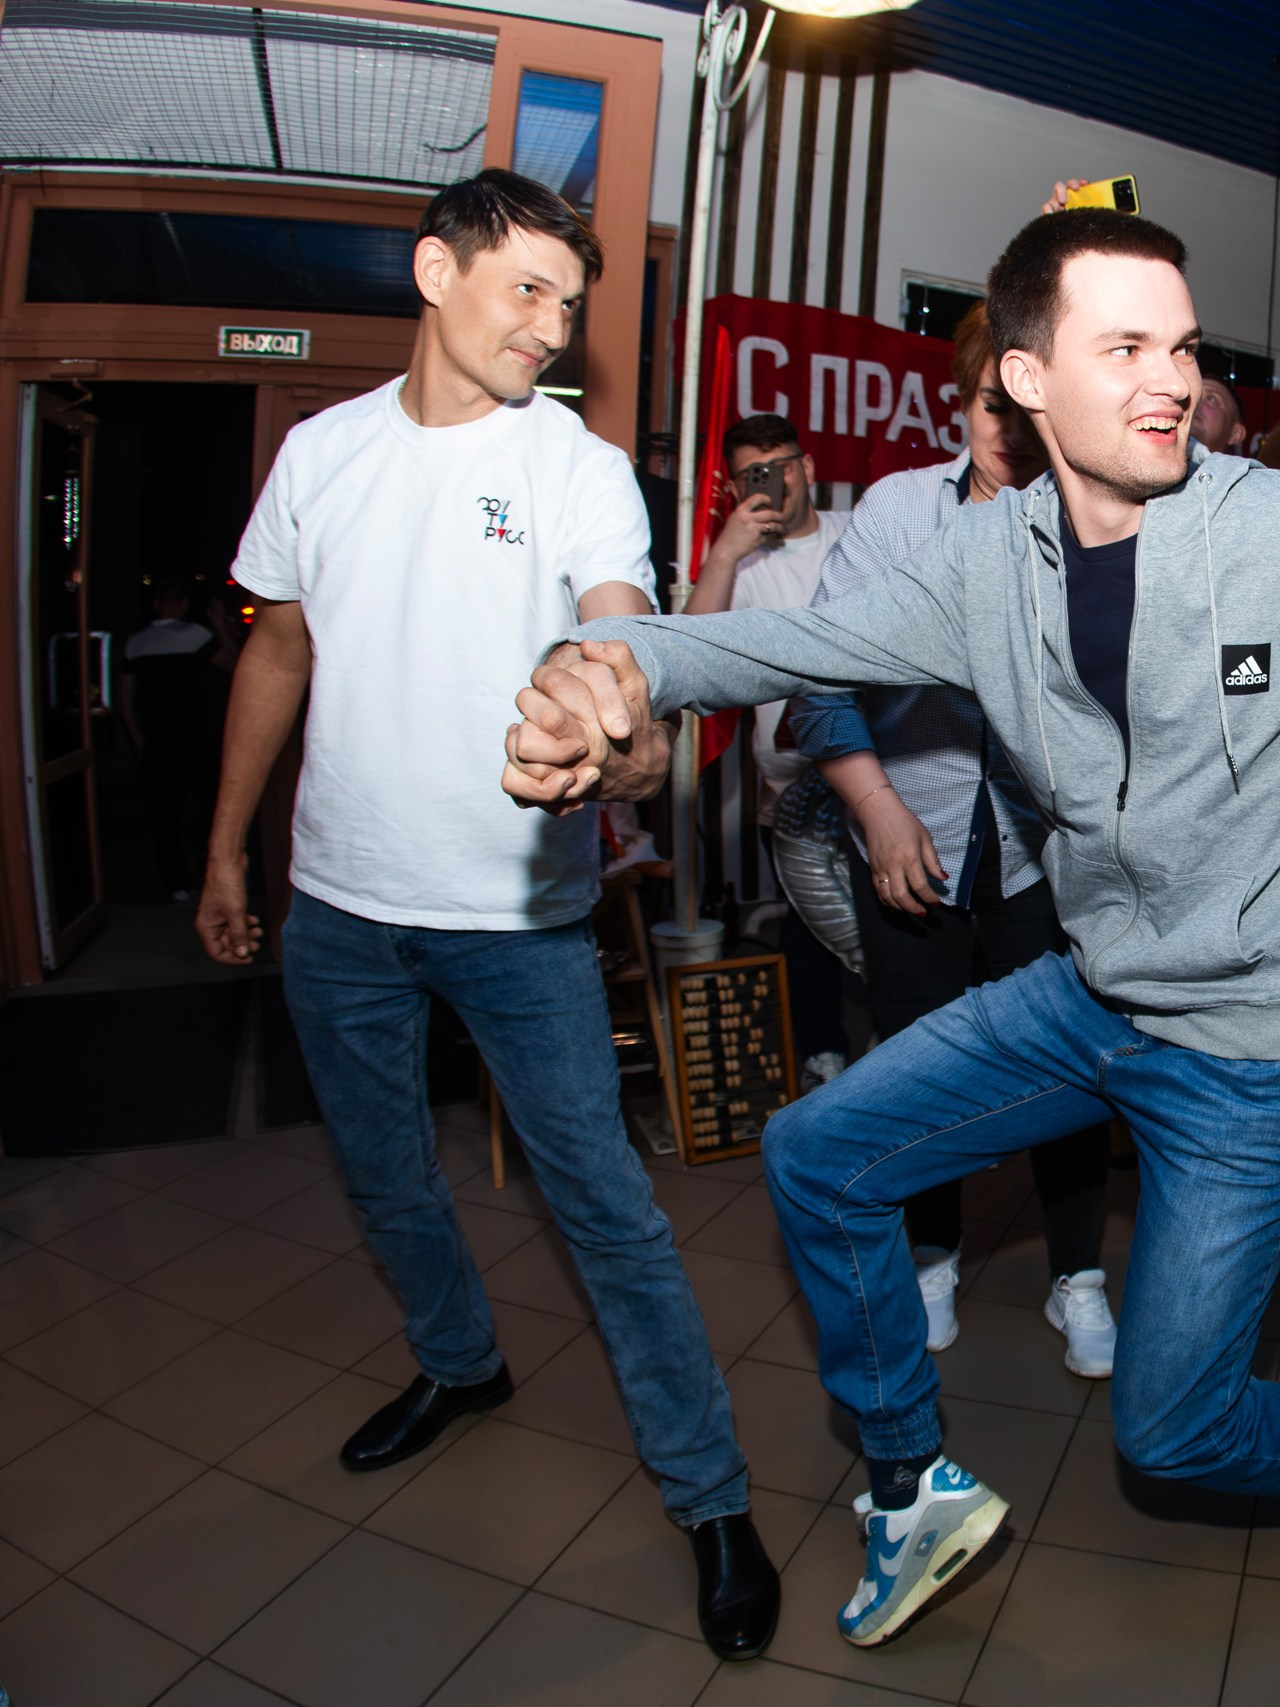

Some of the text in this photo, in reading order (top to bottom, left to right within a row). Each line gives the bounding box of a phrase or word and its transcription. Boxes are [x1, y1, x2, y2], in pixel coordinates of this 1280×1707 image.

[230, 333, 299, 354] ВЫХОД
[737, 335, 789, 419] С
[1225, 673, 1268, 686] adidas
